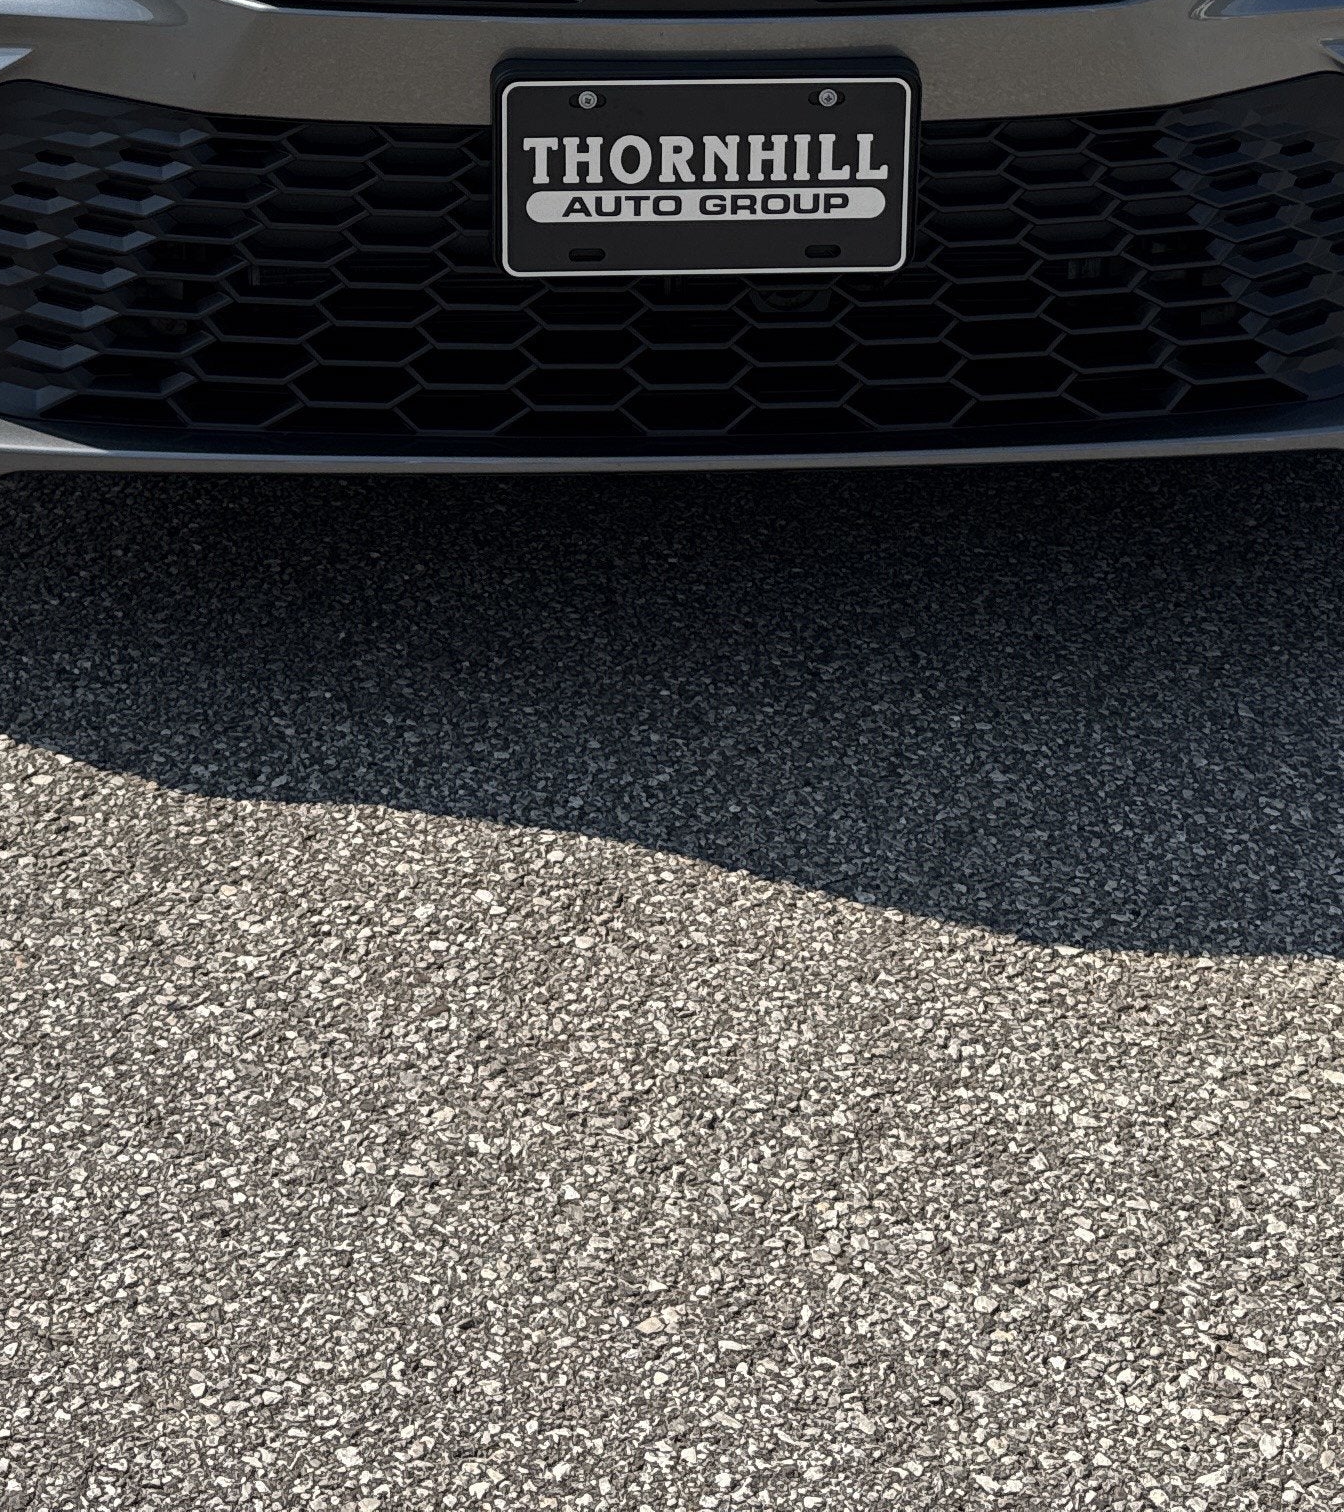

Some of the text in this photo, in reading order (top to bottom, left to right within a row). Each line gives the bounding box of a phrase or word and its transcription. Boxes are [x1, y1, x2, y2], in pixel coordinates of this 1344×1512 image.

[523, 133, 889, 185] THORNHILL
[562, 192, 850, 218] AUTO GROUP
